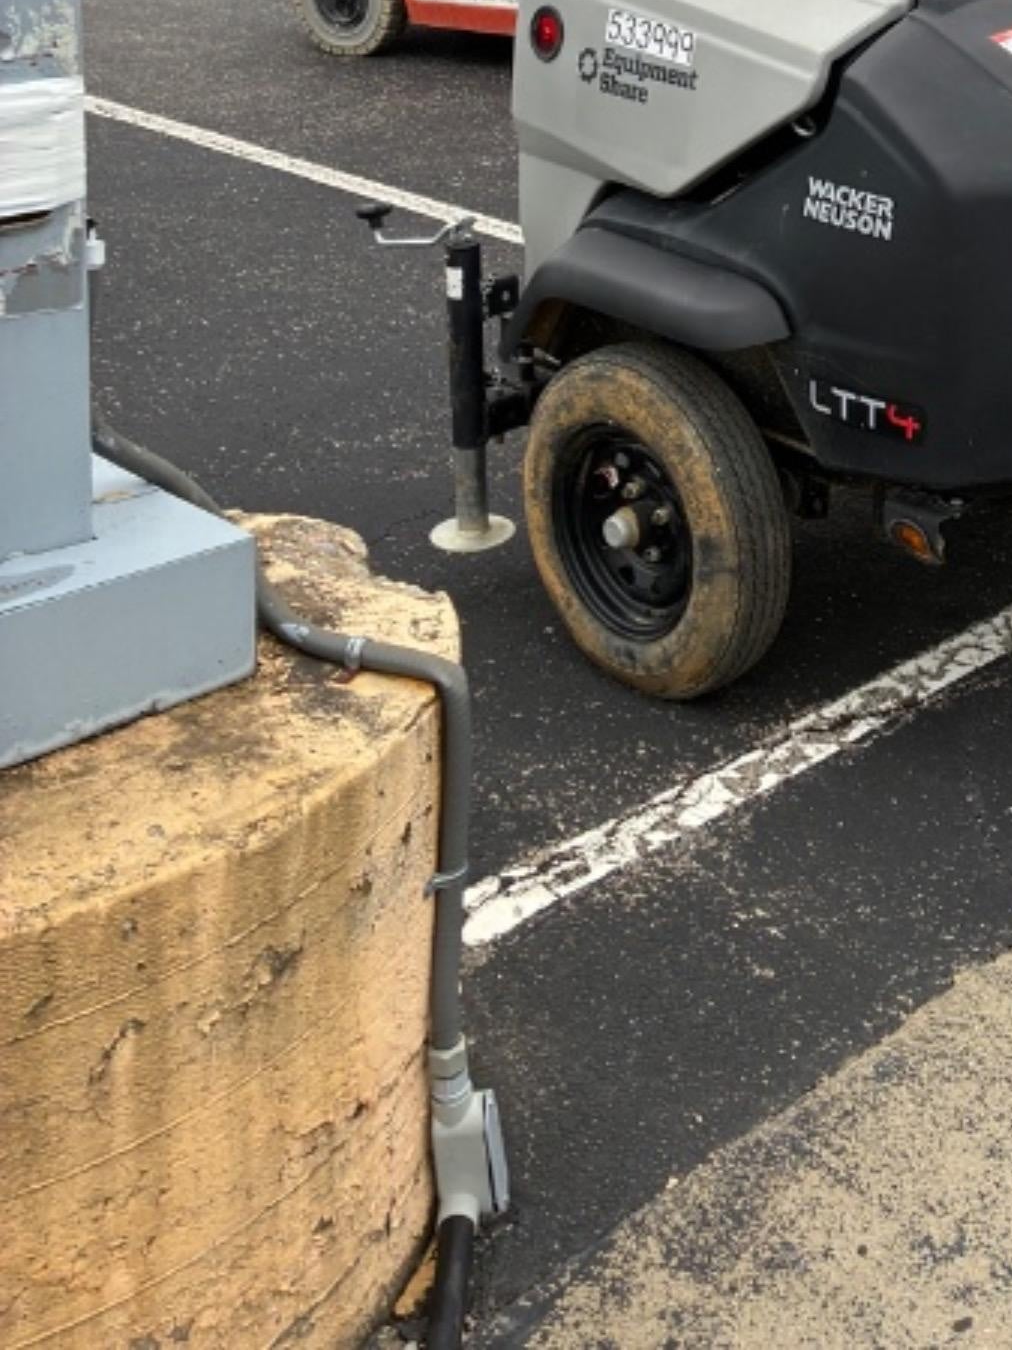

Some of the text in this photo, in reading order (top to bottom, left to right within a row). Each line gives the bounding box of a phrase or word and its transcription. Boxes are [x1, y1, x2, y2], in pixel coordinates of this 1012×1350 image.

[607, 11, 694, 70] 533999
[599, 72, 648, 103] Share
[602, 48, 698, 90] Equipment
[803, 197, 892, 241] NEUSON
[808, 176, 894, 220] WACKER
[809, 380, 920, 440] LTT4
